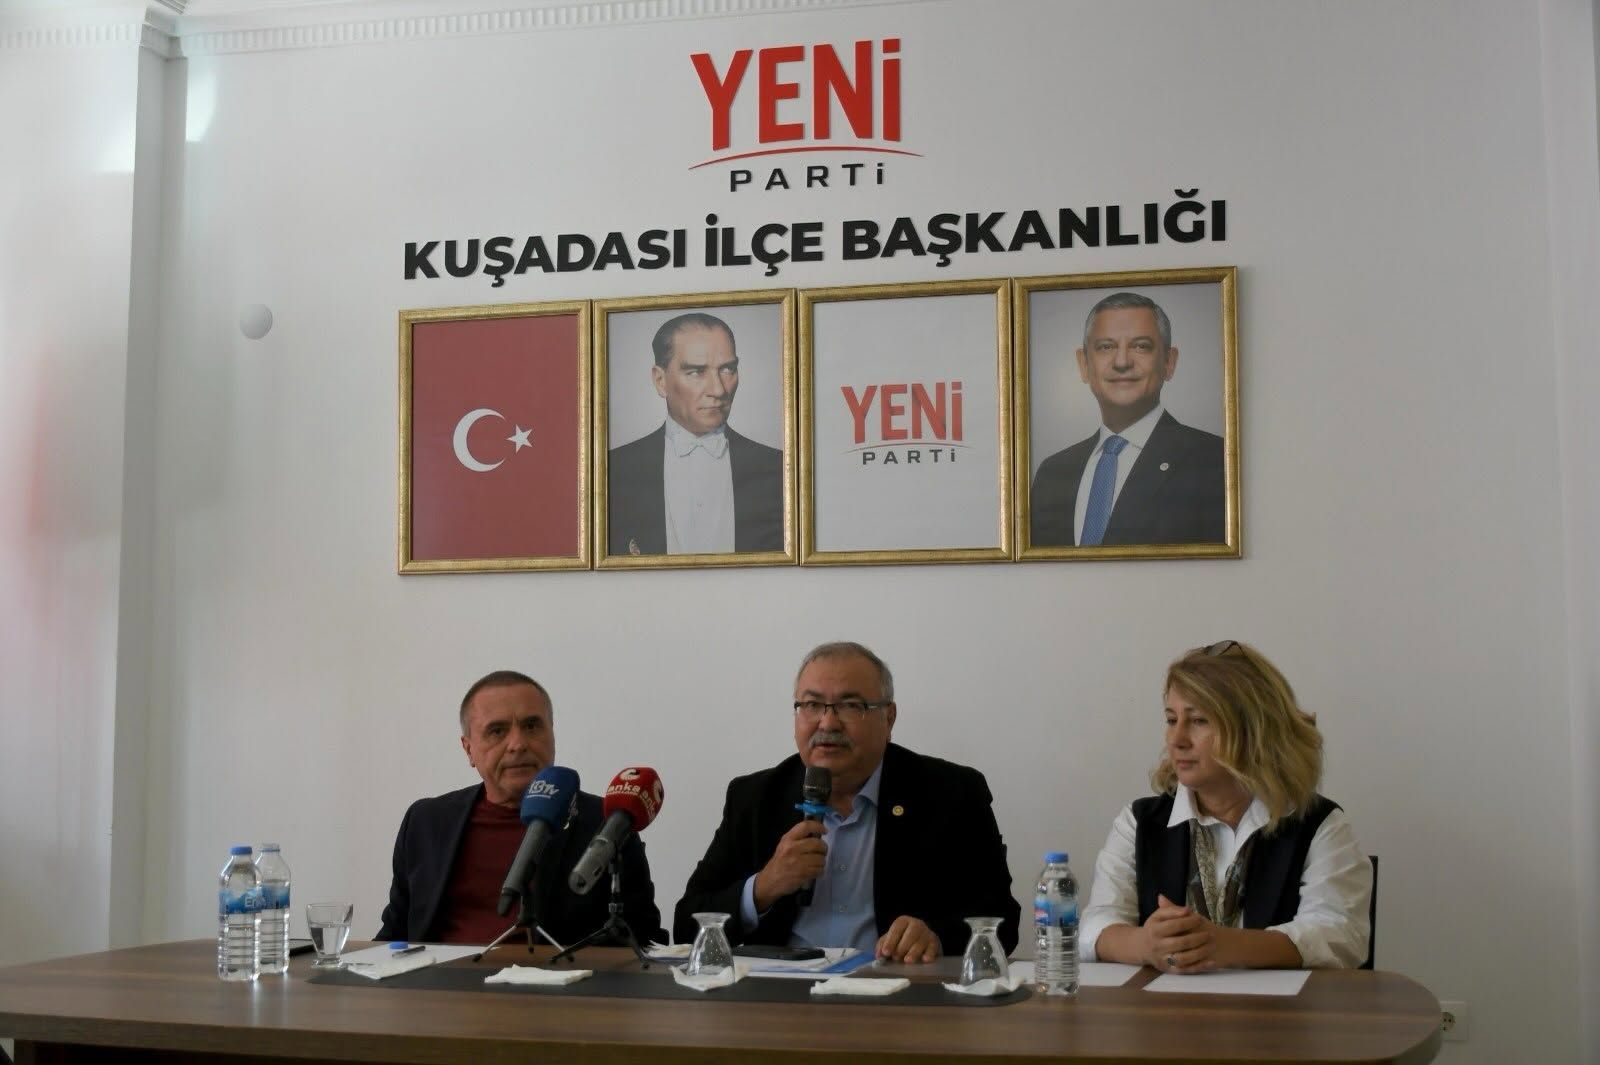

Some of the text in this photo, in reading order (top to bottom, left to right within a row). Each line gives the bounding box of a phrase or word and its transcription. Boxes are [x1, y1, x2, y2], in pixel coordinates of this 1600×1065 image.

[404, 188, 1226, 288] KUŞADASI İLÇE BAŞKANLIĞI
